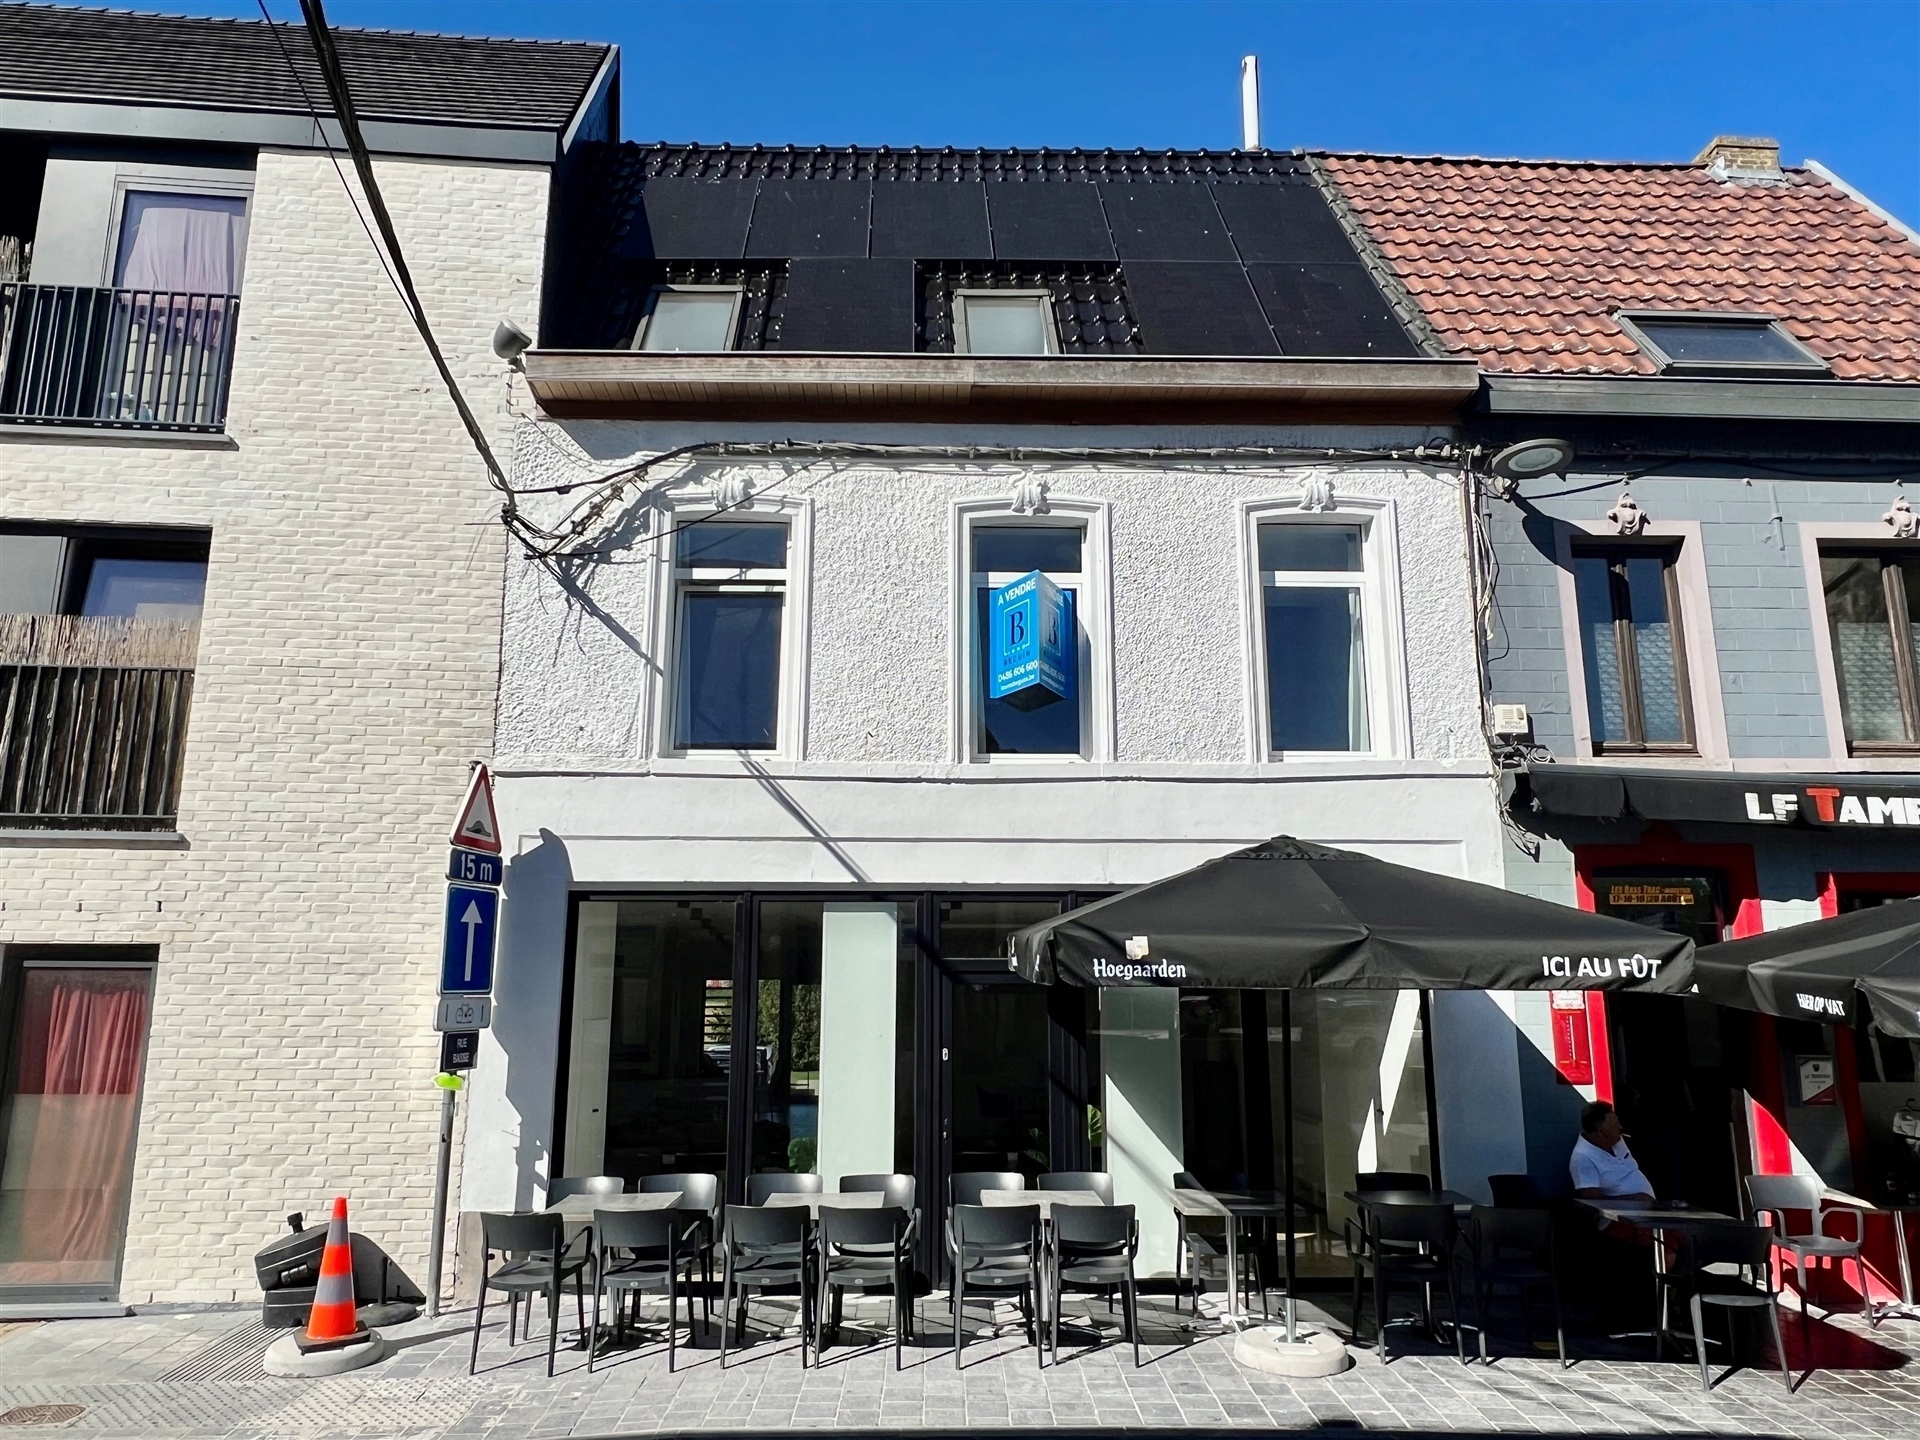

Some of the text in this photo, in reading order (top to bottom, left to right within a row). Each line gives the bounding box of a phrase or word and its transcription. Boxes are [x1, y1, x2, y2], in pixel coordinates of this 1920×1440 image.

[998, 594, 1004, 606] A
[1005, 577, 1037, 602] VENDRE
[1010, 610, 1025, 647] B
[1003, 649, 1031, 666] BEGUIN
[461, 853, 492, 881] 15 m
[1093, 958, 1186, 980] Hoegaarden
[1542, 953, 1662, 979] ICI AU FÛT
[1796, 993, 1846, 1016] HIER OP VAT
